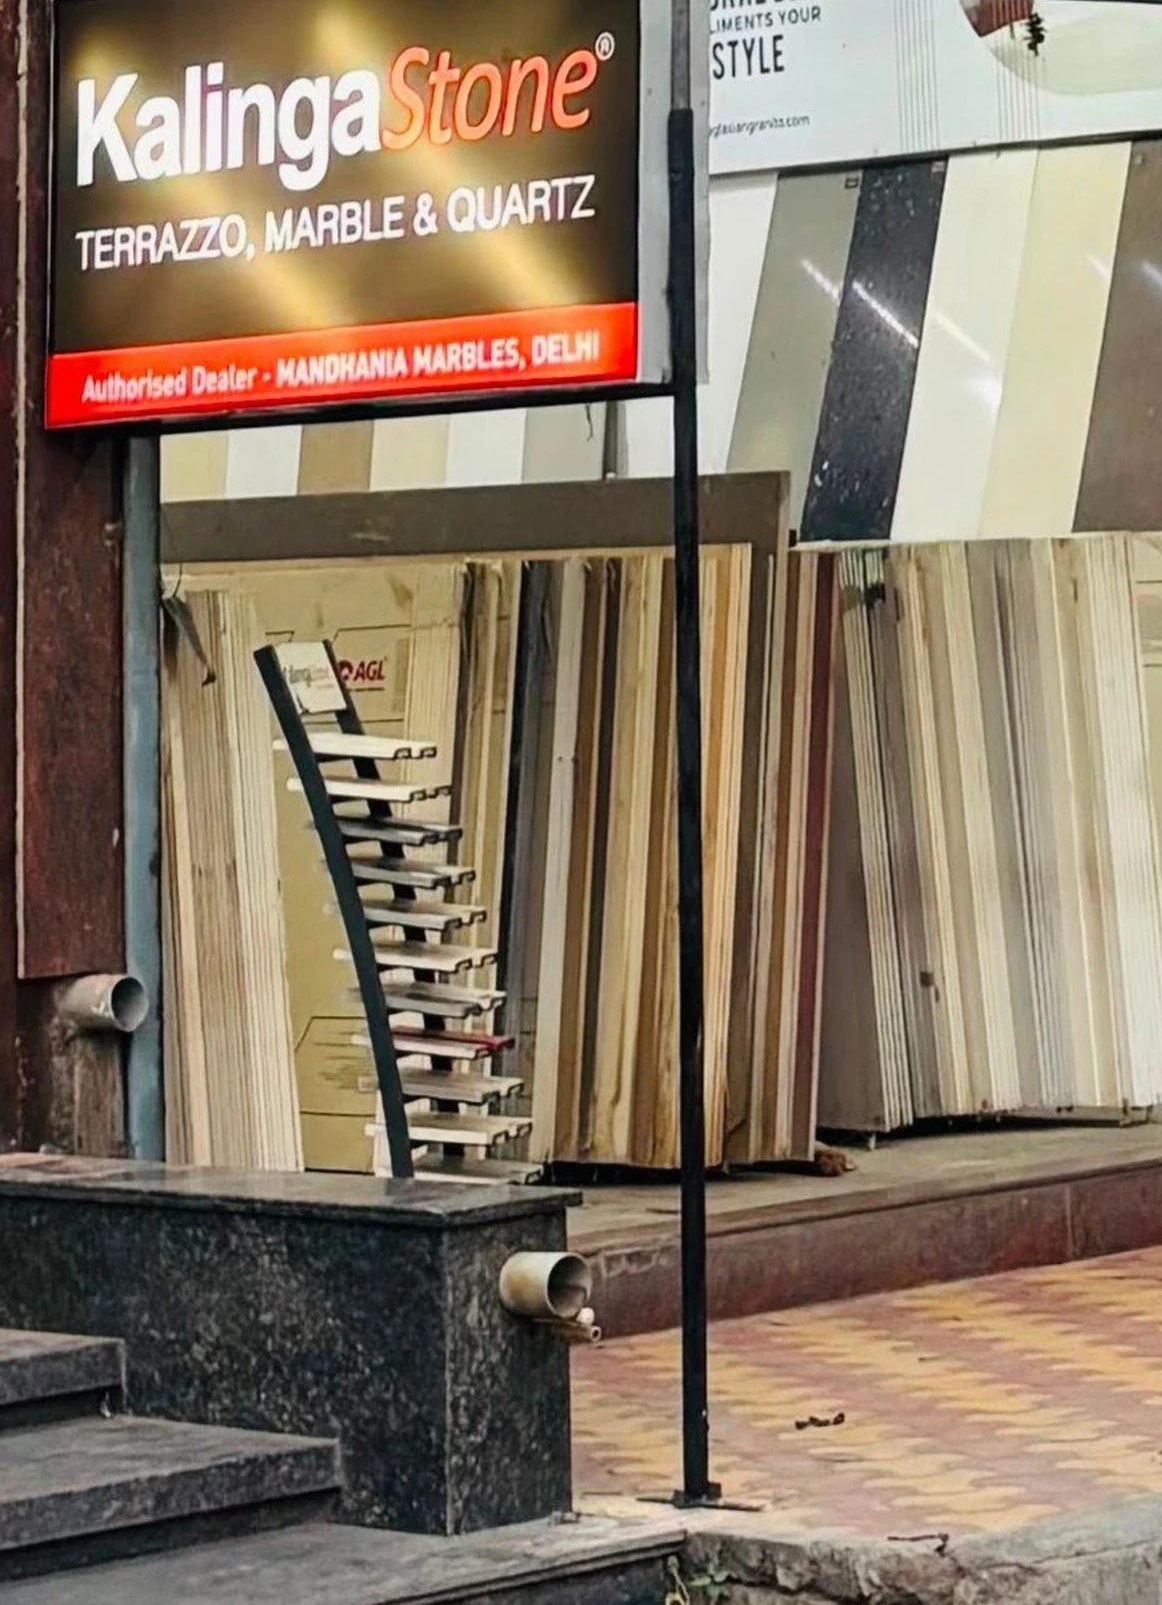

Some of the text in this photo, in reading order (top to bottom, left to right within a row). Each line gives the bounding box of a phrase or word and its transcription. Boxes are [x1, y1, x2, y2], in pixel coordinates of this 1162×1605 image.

[778, 5, 822, 26] YOUR
[712, 34, 785, 80] STYLE
[75, 174, 596, 271] TERRAZZO, MARBLE & QUARTZ
[81, 367, 187, 403] Authorised
[192, 363, 257, 395] Dealer
[276, 344, 408, 387] MANDHANIA
[412, 338, 527, 374] MARBLES,
[531, 330, 601, 366] DELHI
[353, 660, 385, 681] AGL
